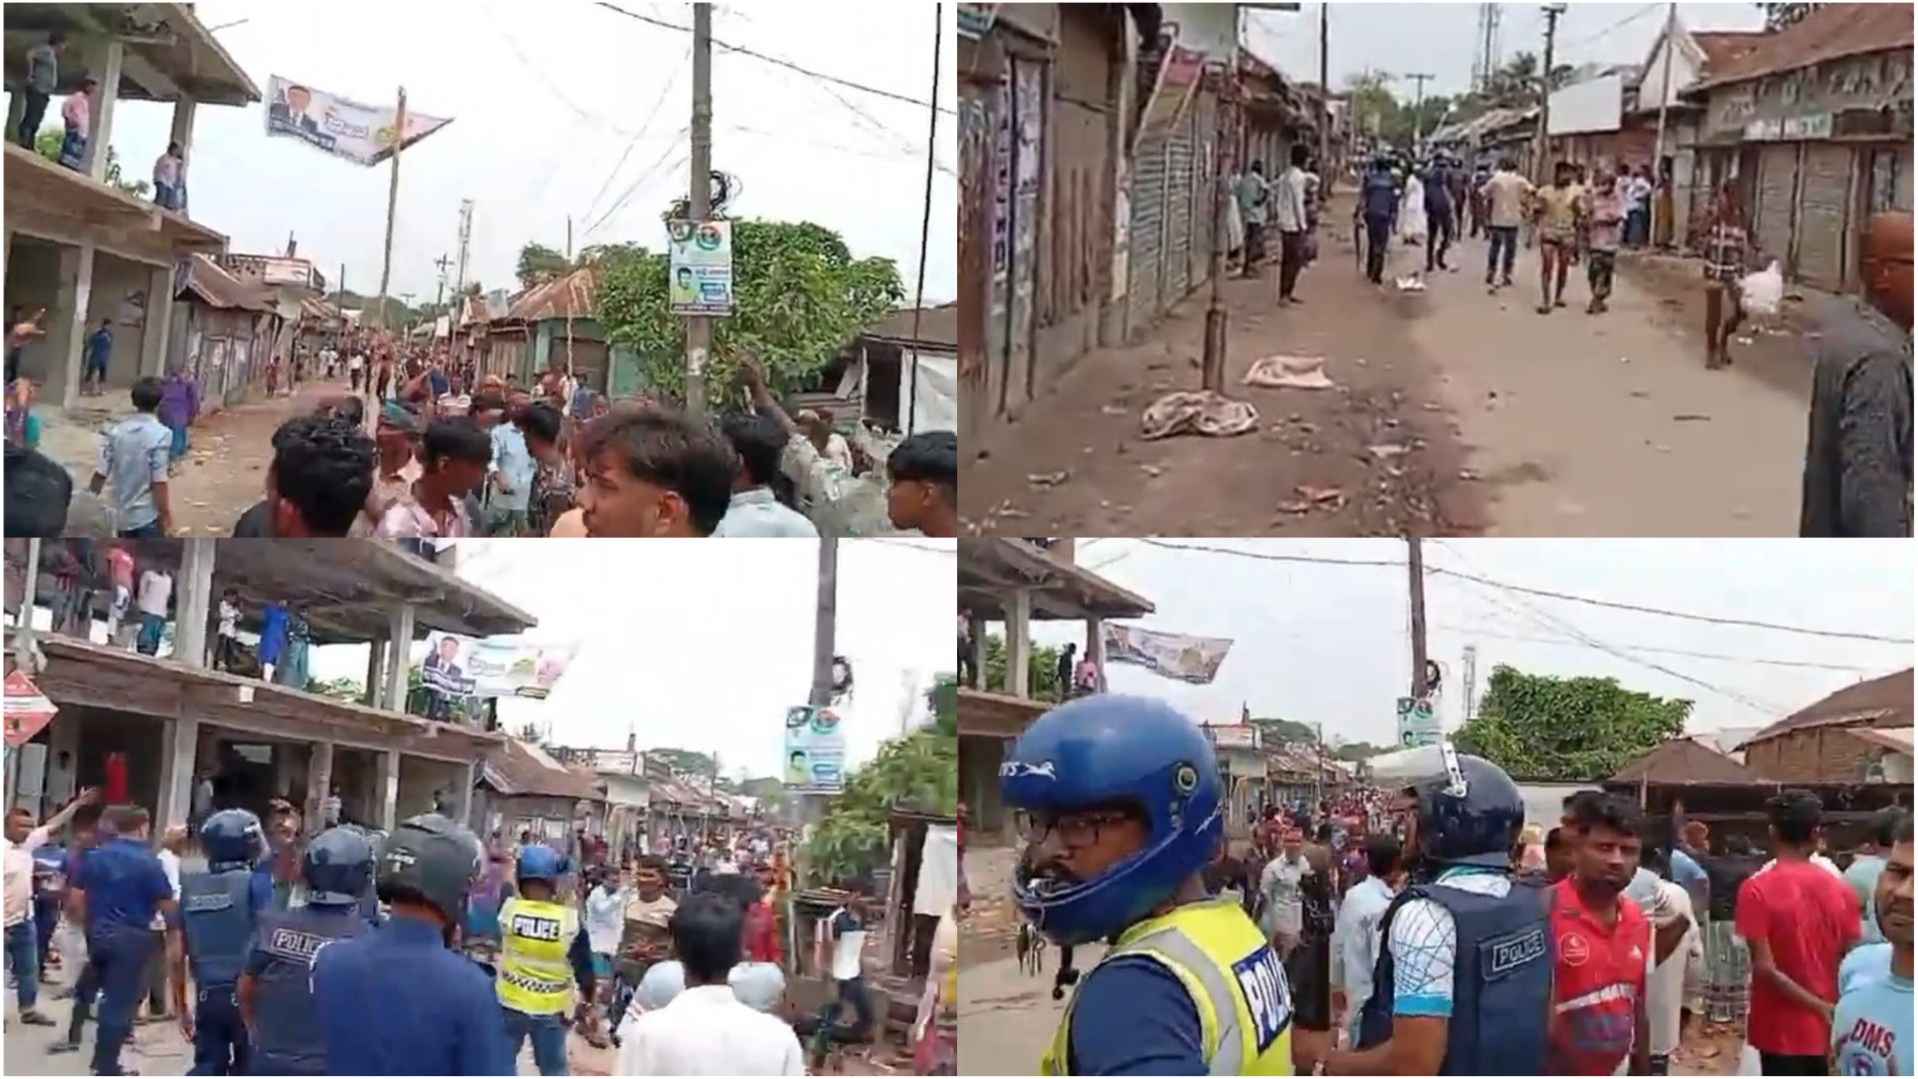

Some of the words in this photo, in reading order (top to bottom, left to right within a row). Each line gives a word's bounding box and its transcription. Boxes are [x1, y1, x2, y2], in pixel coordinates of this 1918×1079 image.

[276, 932, 321, 954] POLIC
[1499, 934, 1542, 965] POLICE
[1850, 1018, 1895, 1058] DMS
